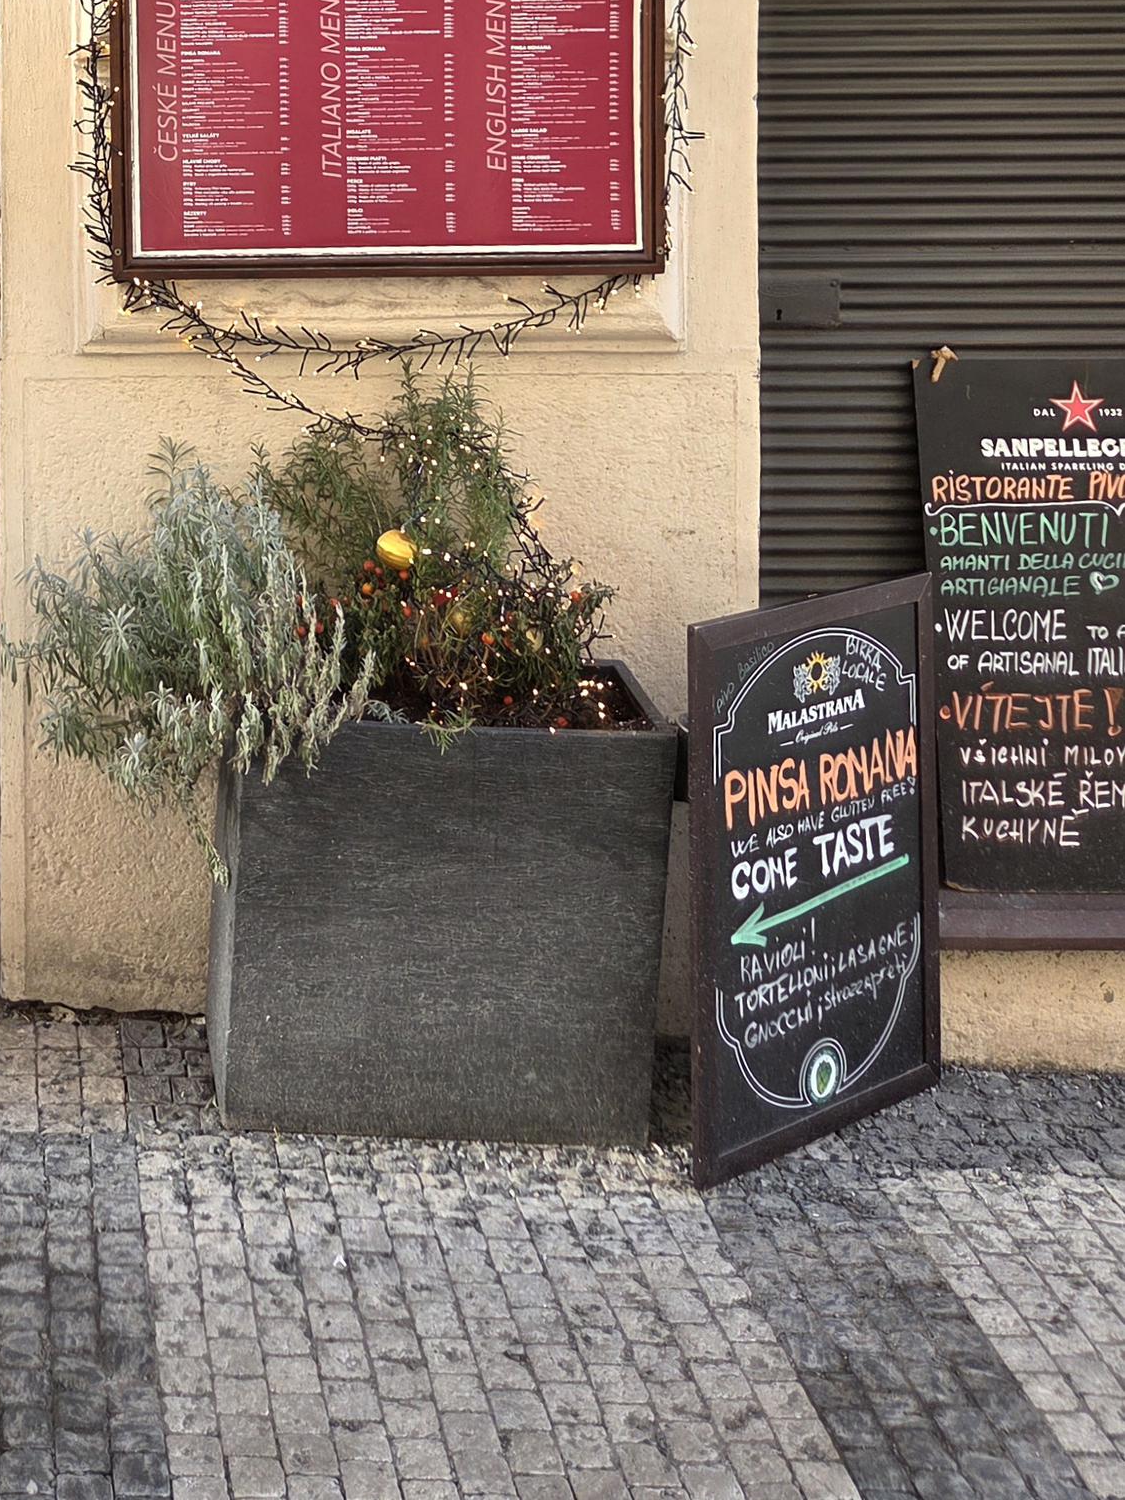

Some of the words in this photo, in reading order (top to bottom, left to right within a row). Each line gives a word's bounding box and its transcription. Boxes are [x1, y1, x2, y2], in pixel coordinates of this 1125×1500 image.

[156, 1, 177, 76] MENU
[152, 83, 178, 162] ČESKÉ
[320, 62, 342, 178] ITALIANO
[486, 64, 507, 171] ENGLISH
[1033, 408, 1056, 417] DAL
[1098, 408, 1123, 417] 1932
[1001, 462, 1046, 471] ITALIAN
[1051, 462, 1115, 471] SPARKLING
[931, 469, 1075, 503] RISTORANTE
[939, 511, 1109, 549] BENVENUTI
[940, 554, 1010, 572] AMANTI
[1017, 552, 1074, 571] DELLA
[1078, 552, 1125, 570] CUCI
[940, 575, 1082, 598] ARTIGIANALE
[944, 608, 1068, 643] WELCOME
[1086, 625, 1110, 640] TO
[846, 634, 882, 673] BIRRA
[947, 655, 970, 671] OF
[977, 650, 1080, 676] ARTISANAL
[1087, 646, 1125, 677] ITALI
[841, 660, 887, 692] LOCALE
[767, 688, 866, 735] MALASTRANA
[959, 738, 1049, 767] VŠICHNI
[725, 757, 810, 831] PINSA
[819, 725, 917, 806] ROMANA
[731, 833, 760, 858] WE
[766, 823, 794, 848] ALSO
[797, 810, 825, 835] HAVE
[961, 809, 1090, 847] KUCHYNĚ
[731, 847, 798, 900] COME
[812, 813, 895, 878] TASTE
